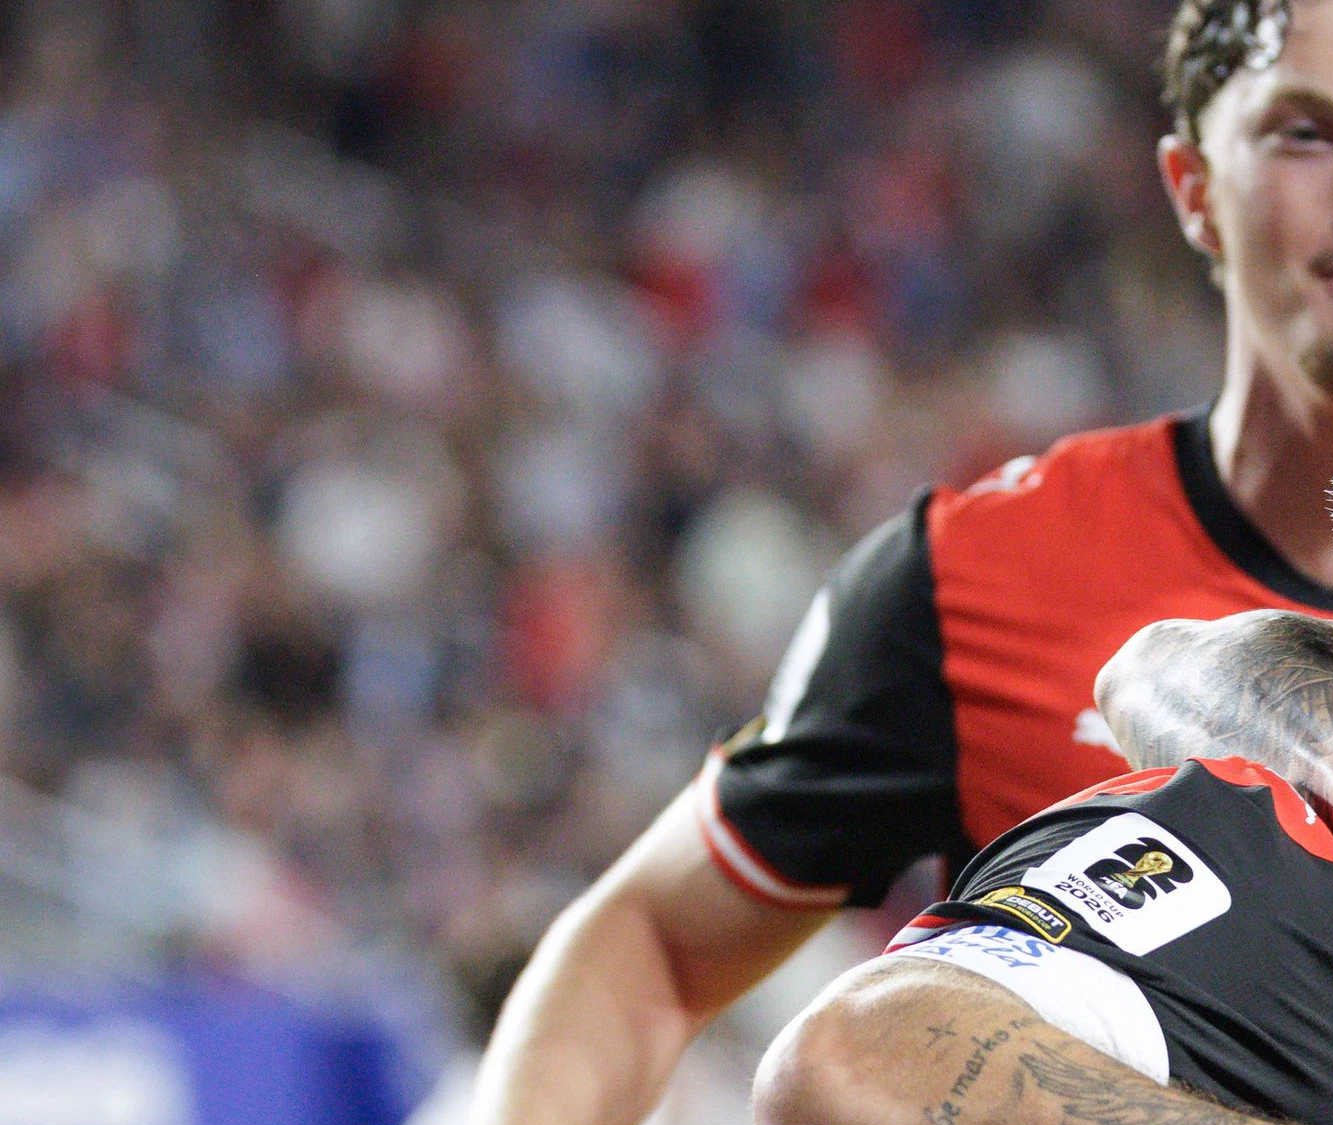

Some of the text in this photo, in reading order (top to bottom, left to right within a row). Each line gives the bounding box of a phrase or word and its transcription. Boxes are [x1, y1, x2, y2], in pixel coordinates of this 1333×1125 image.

[1006, 896, 1064, 927] DEBUT
[1054, 881, 1114, 924] 2026
[1068, 873, 1124, 918] WORLD CUP
